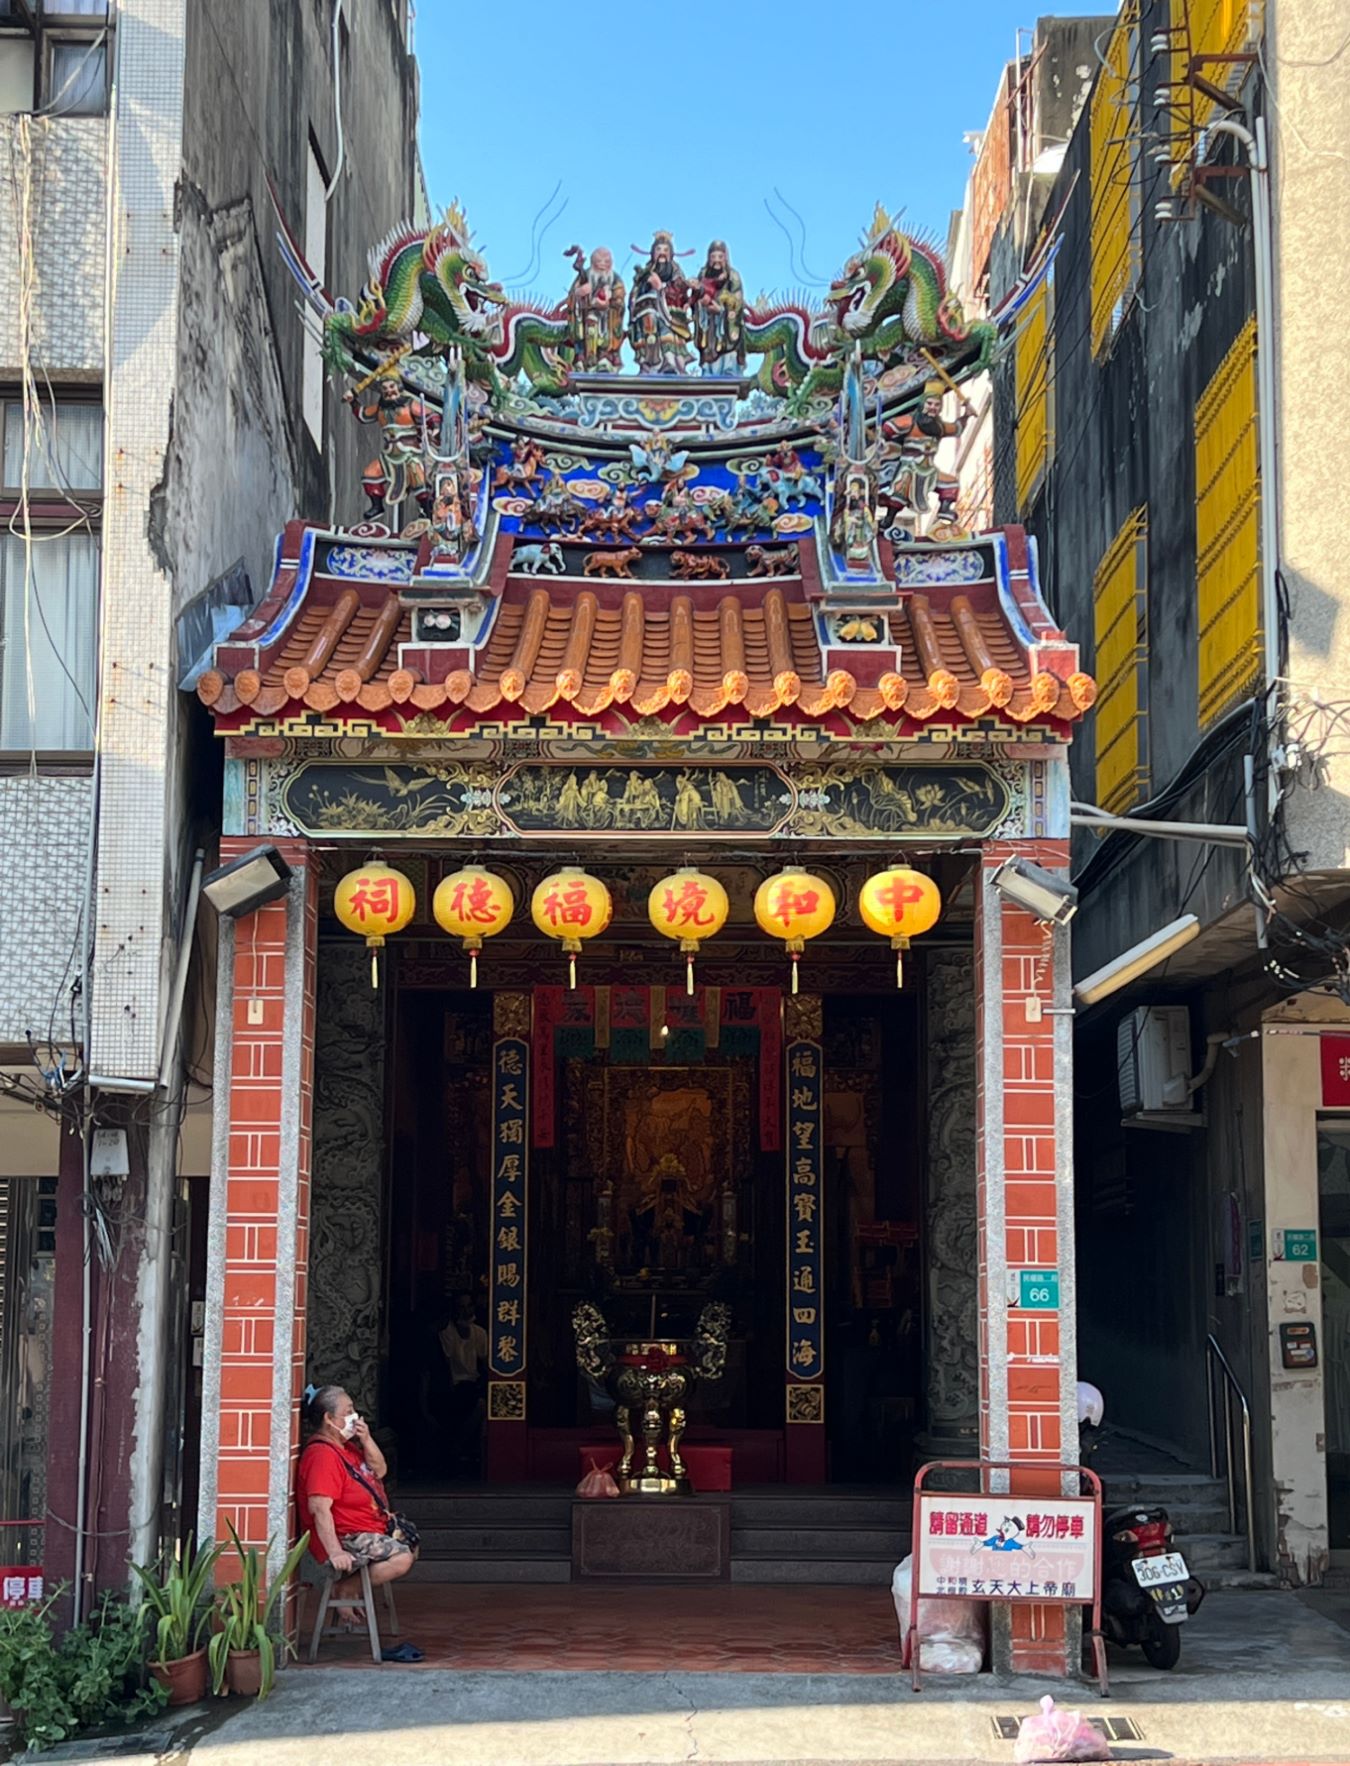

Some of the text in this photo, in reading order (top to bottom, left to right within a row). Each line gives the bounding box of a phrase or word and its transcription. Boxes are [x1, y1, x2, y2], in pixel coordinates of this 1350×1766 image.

[349, 878, 399, 923] 祠
[450, 876, 501, 923] 德
[543, 880, 593, 926] 福
[662, 881, 715, 926] 境
[769, 880, 820, 928] 和
[873, 877, 924, 923] 中
[1292, 1244, 1309, 1255] 62
[1029, 1288, 1050, 1302] 66
[929, 1511, 1084, 1539] 請留通道 請勿停車
